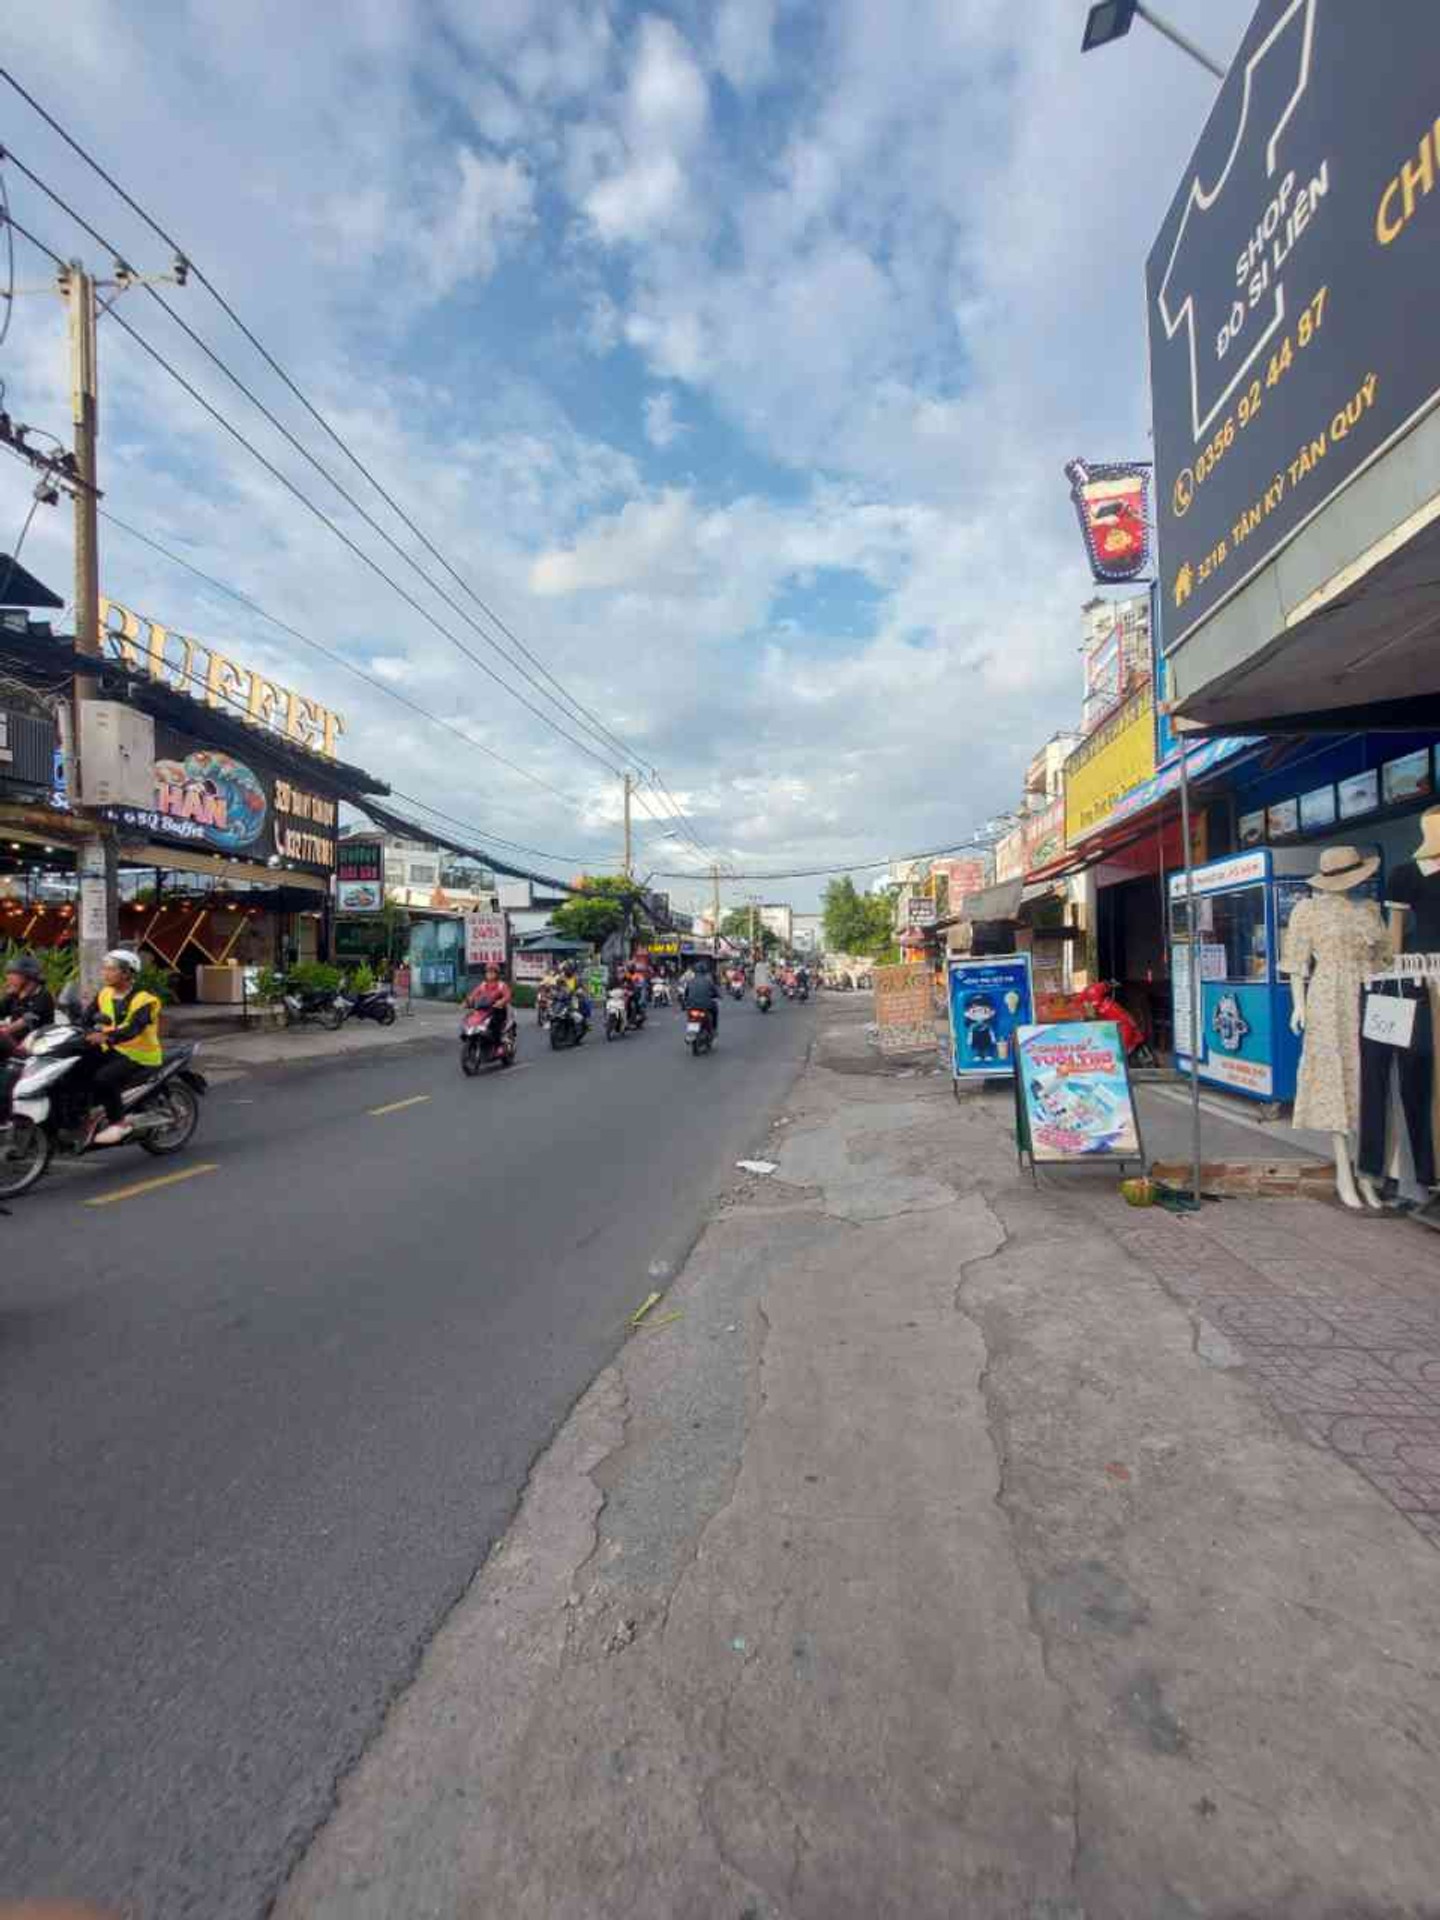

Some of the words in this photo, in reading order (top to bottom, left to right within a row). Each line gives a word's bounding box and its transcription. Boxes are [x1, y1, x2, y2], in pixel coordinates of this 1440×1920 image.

[1236, 171, 1295, 287] SHOP
[1195, 416, 1235, 484] 0356
[1238, 380, 1261, 428] 92
[1266, 336, 1294, 387] 44
[1298, 285, 1329, 348] 87
